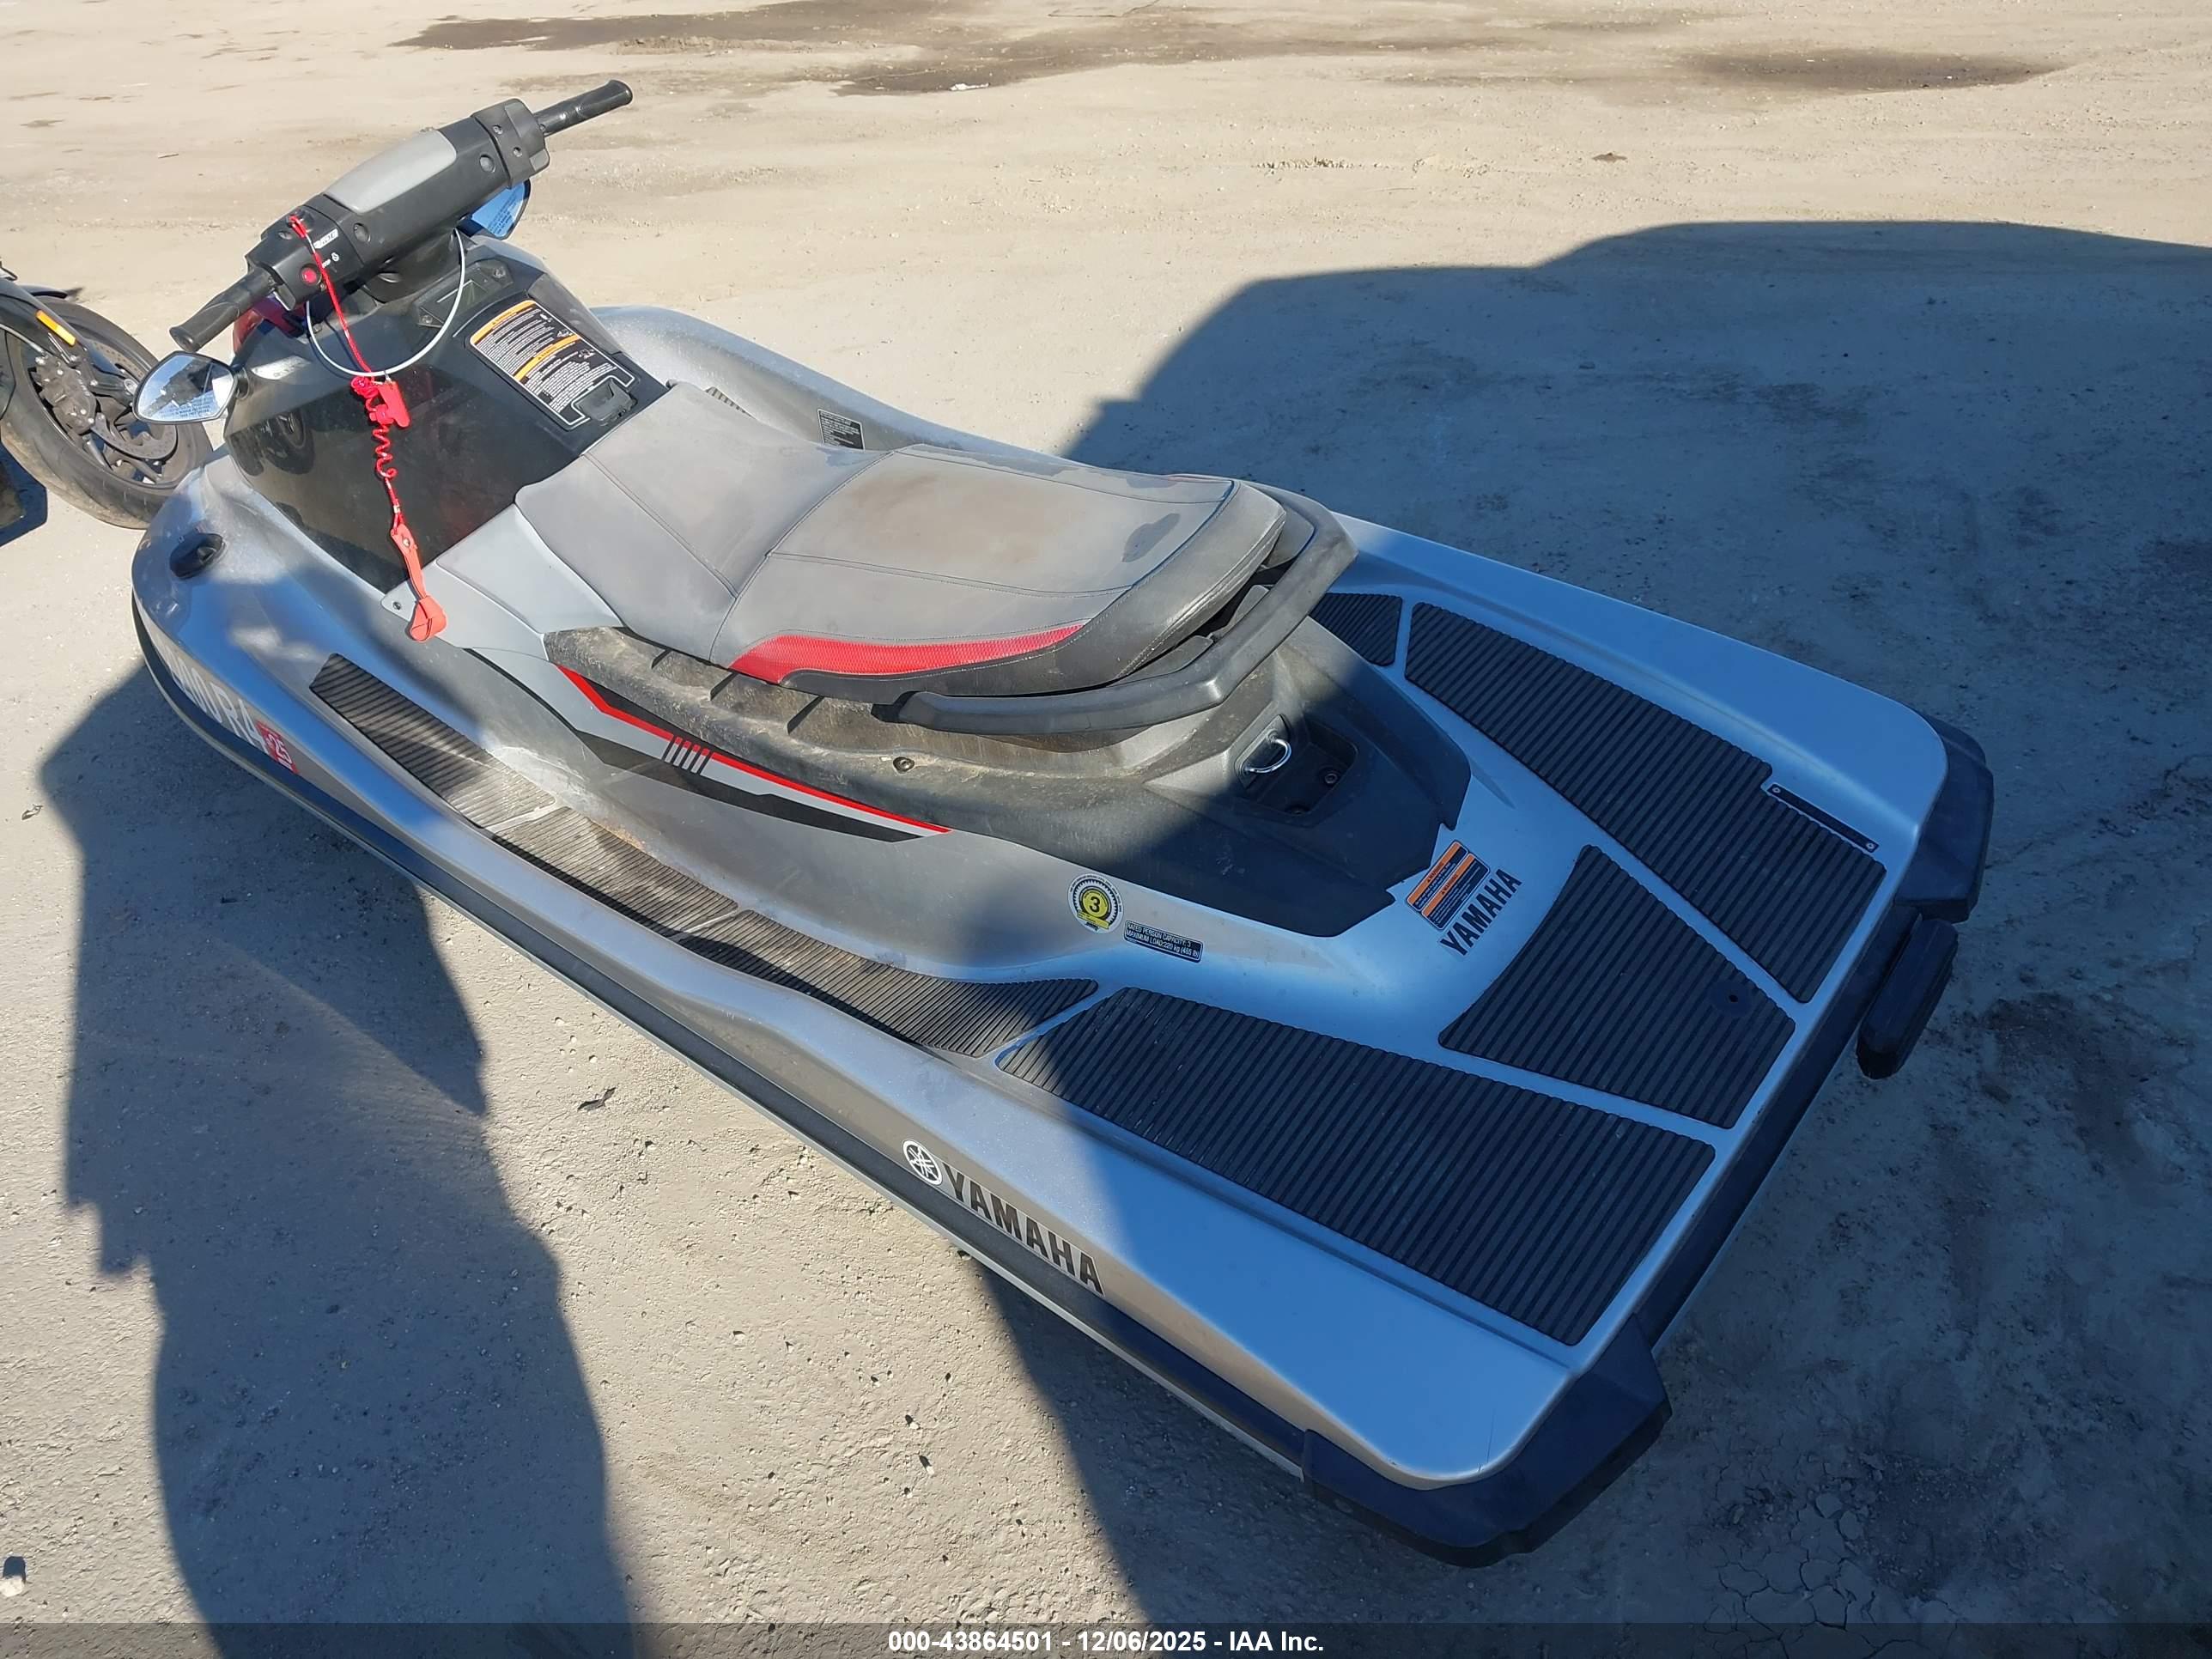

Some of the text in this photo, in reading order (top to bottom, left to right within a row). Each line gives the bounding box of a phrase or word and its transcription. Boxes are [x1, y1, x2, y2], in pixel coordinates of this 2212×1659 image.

[1090, 896, 1101, 913] 3
[1439, 869, 1522, 956] YAMAHA
[942, 1161, 1104, 1295] YAMAHA
